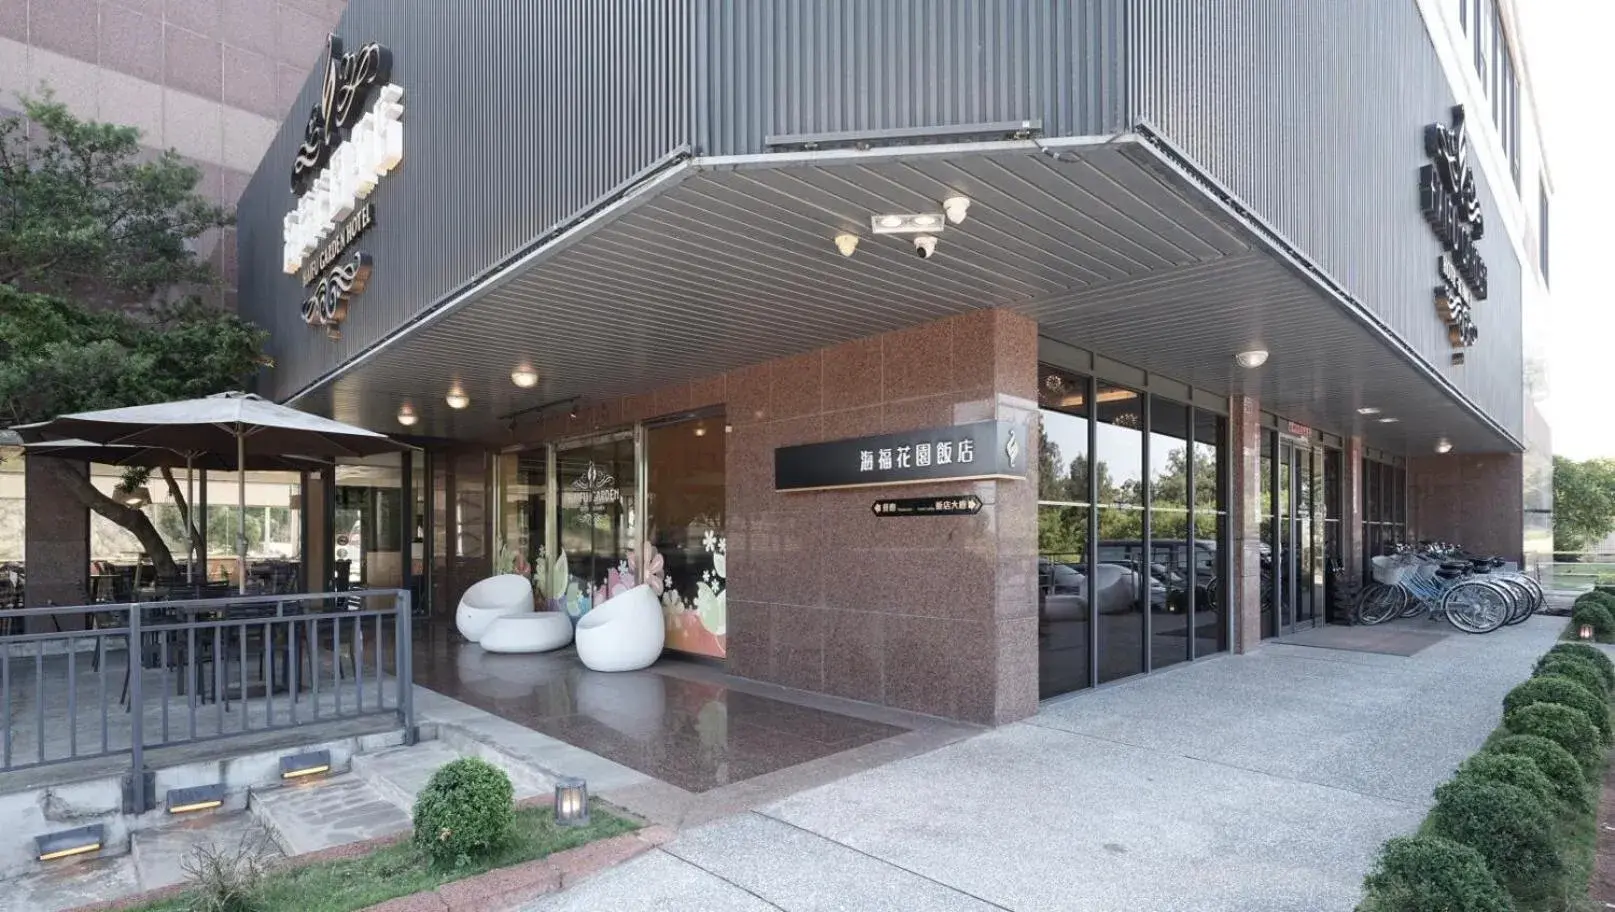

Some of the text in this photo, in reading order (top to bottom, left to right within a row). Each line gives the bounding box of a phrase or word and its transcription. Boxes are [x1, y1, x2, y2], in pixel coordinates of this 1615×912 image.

[346, 203, 371, 244] HOTEL
[860, 439, 974, 472] 海福花園飯店
